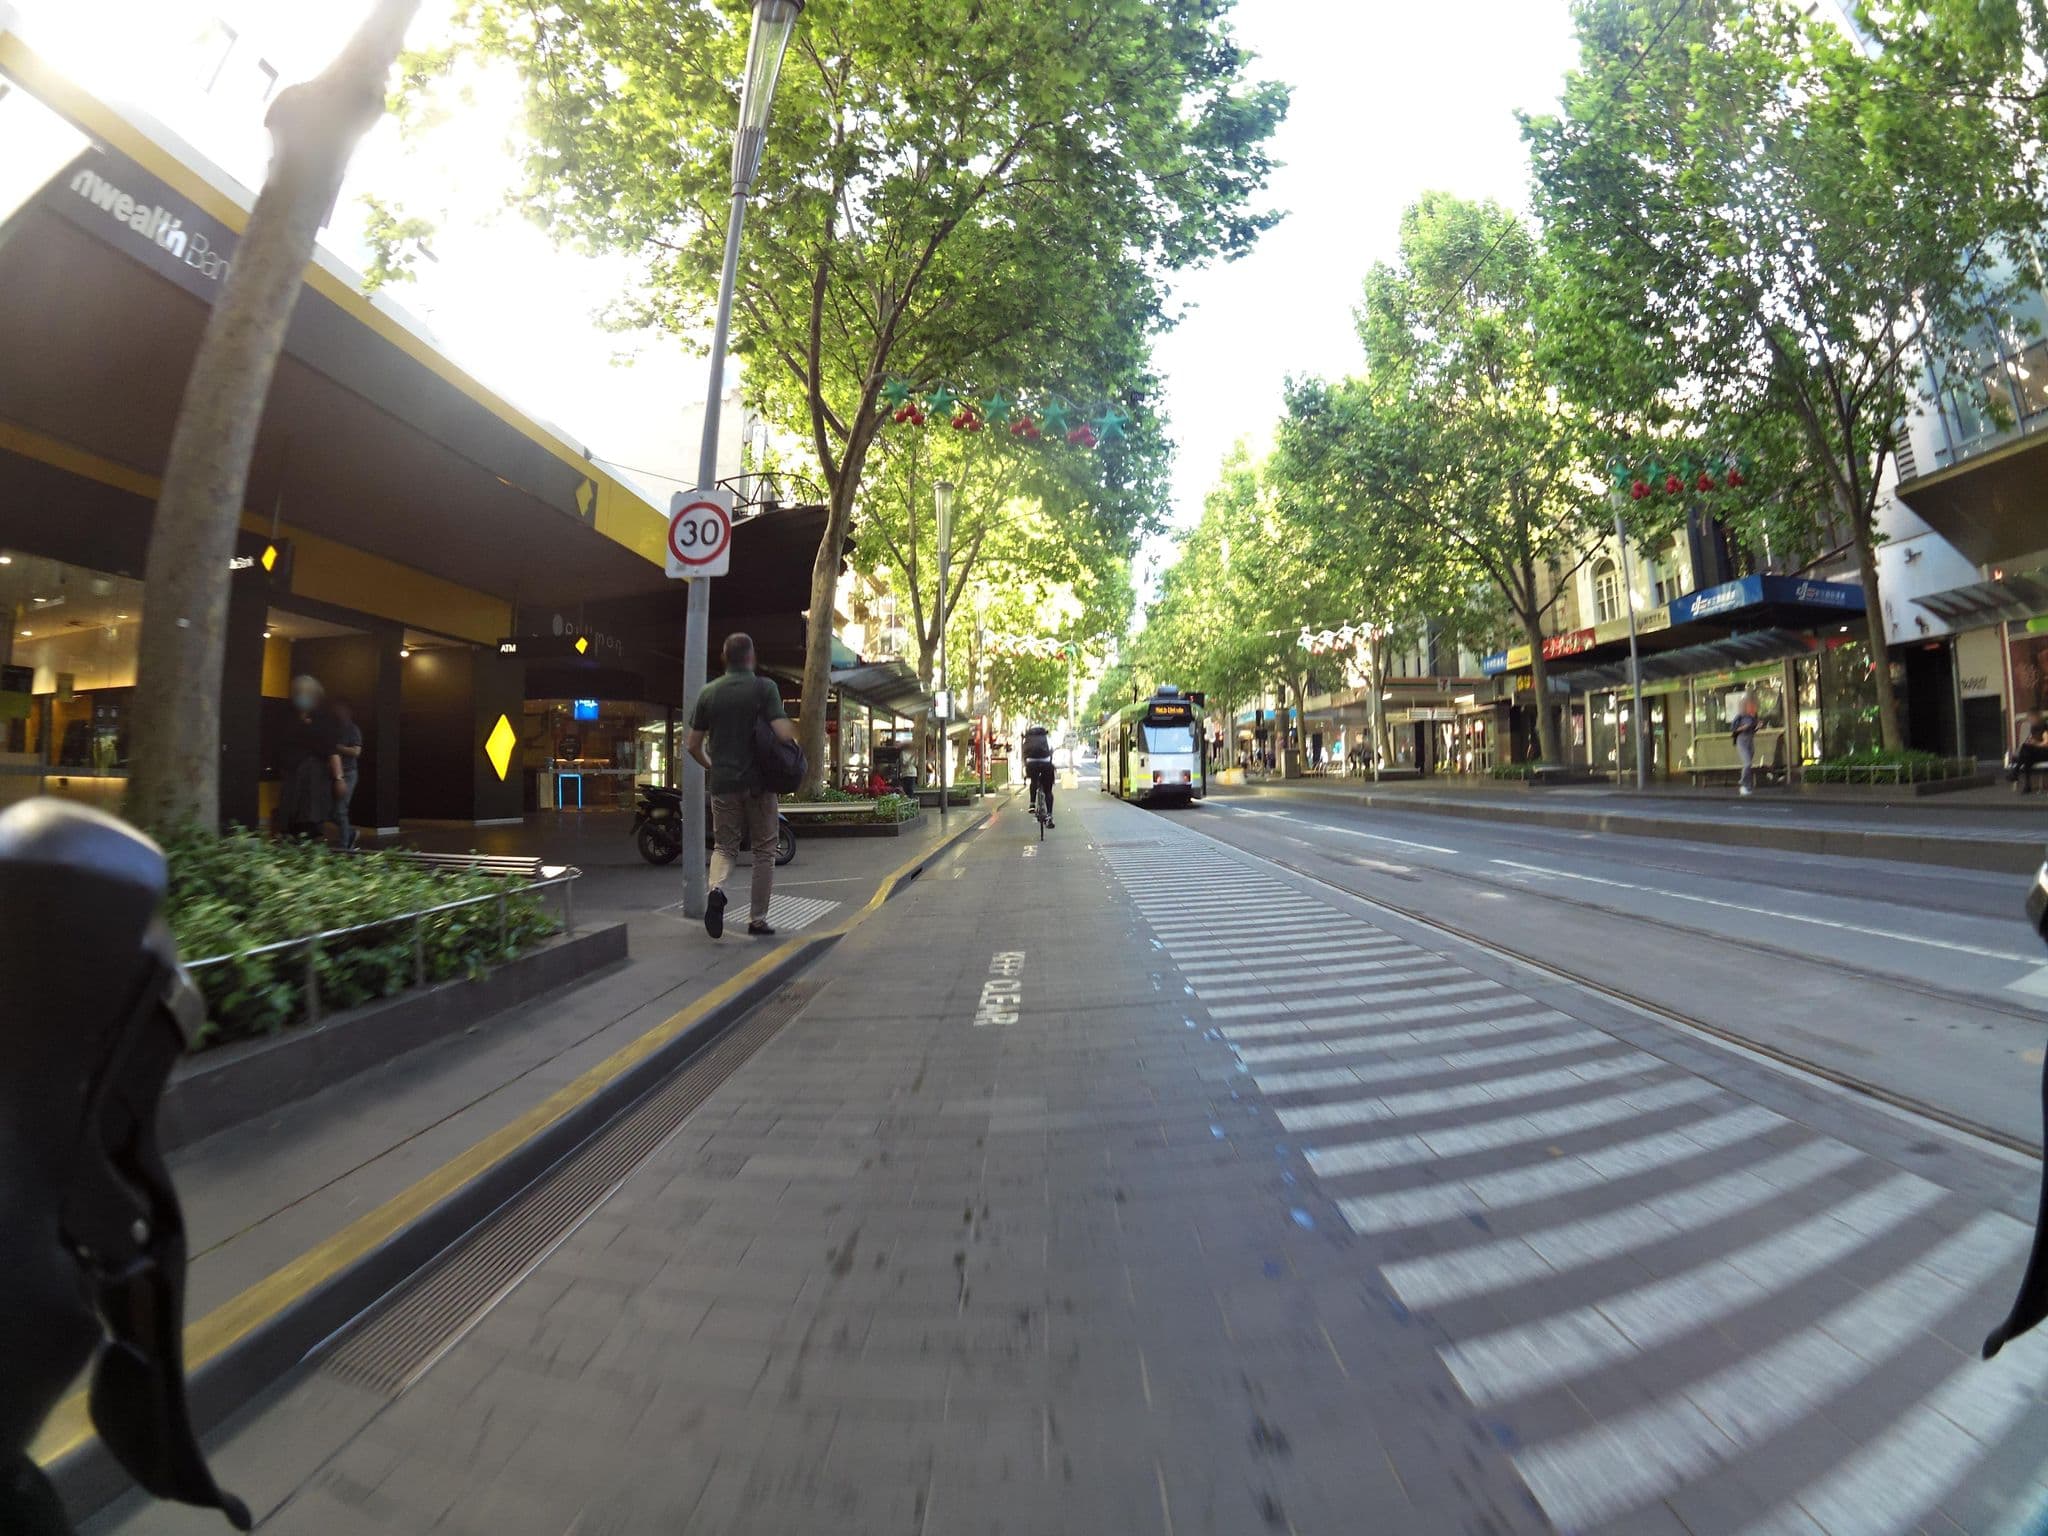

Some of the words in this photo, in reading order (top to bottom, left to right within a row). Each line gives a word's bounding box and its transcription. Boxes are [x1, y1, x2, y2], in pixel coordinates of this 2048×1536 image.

[680, 519, 720, 547] 30
[500, 643, 517, 653] ATM
[973, 979, 1022, 1026] CLEAR
